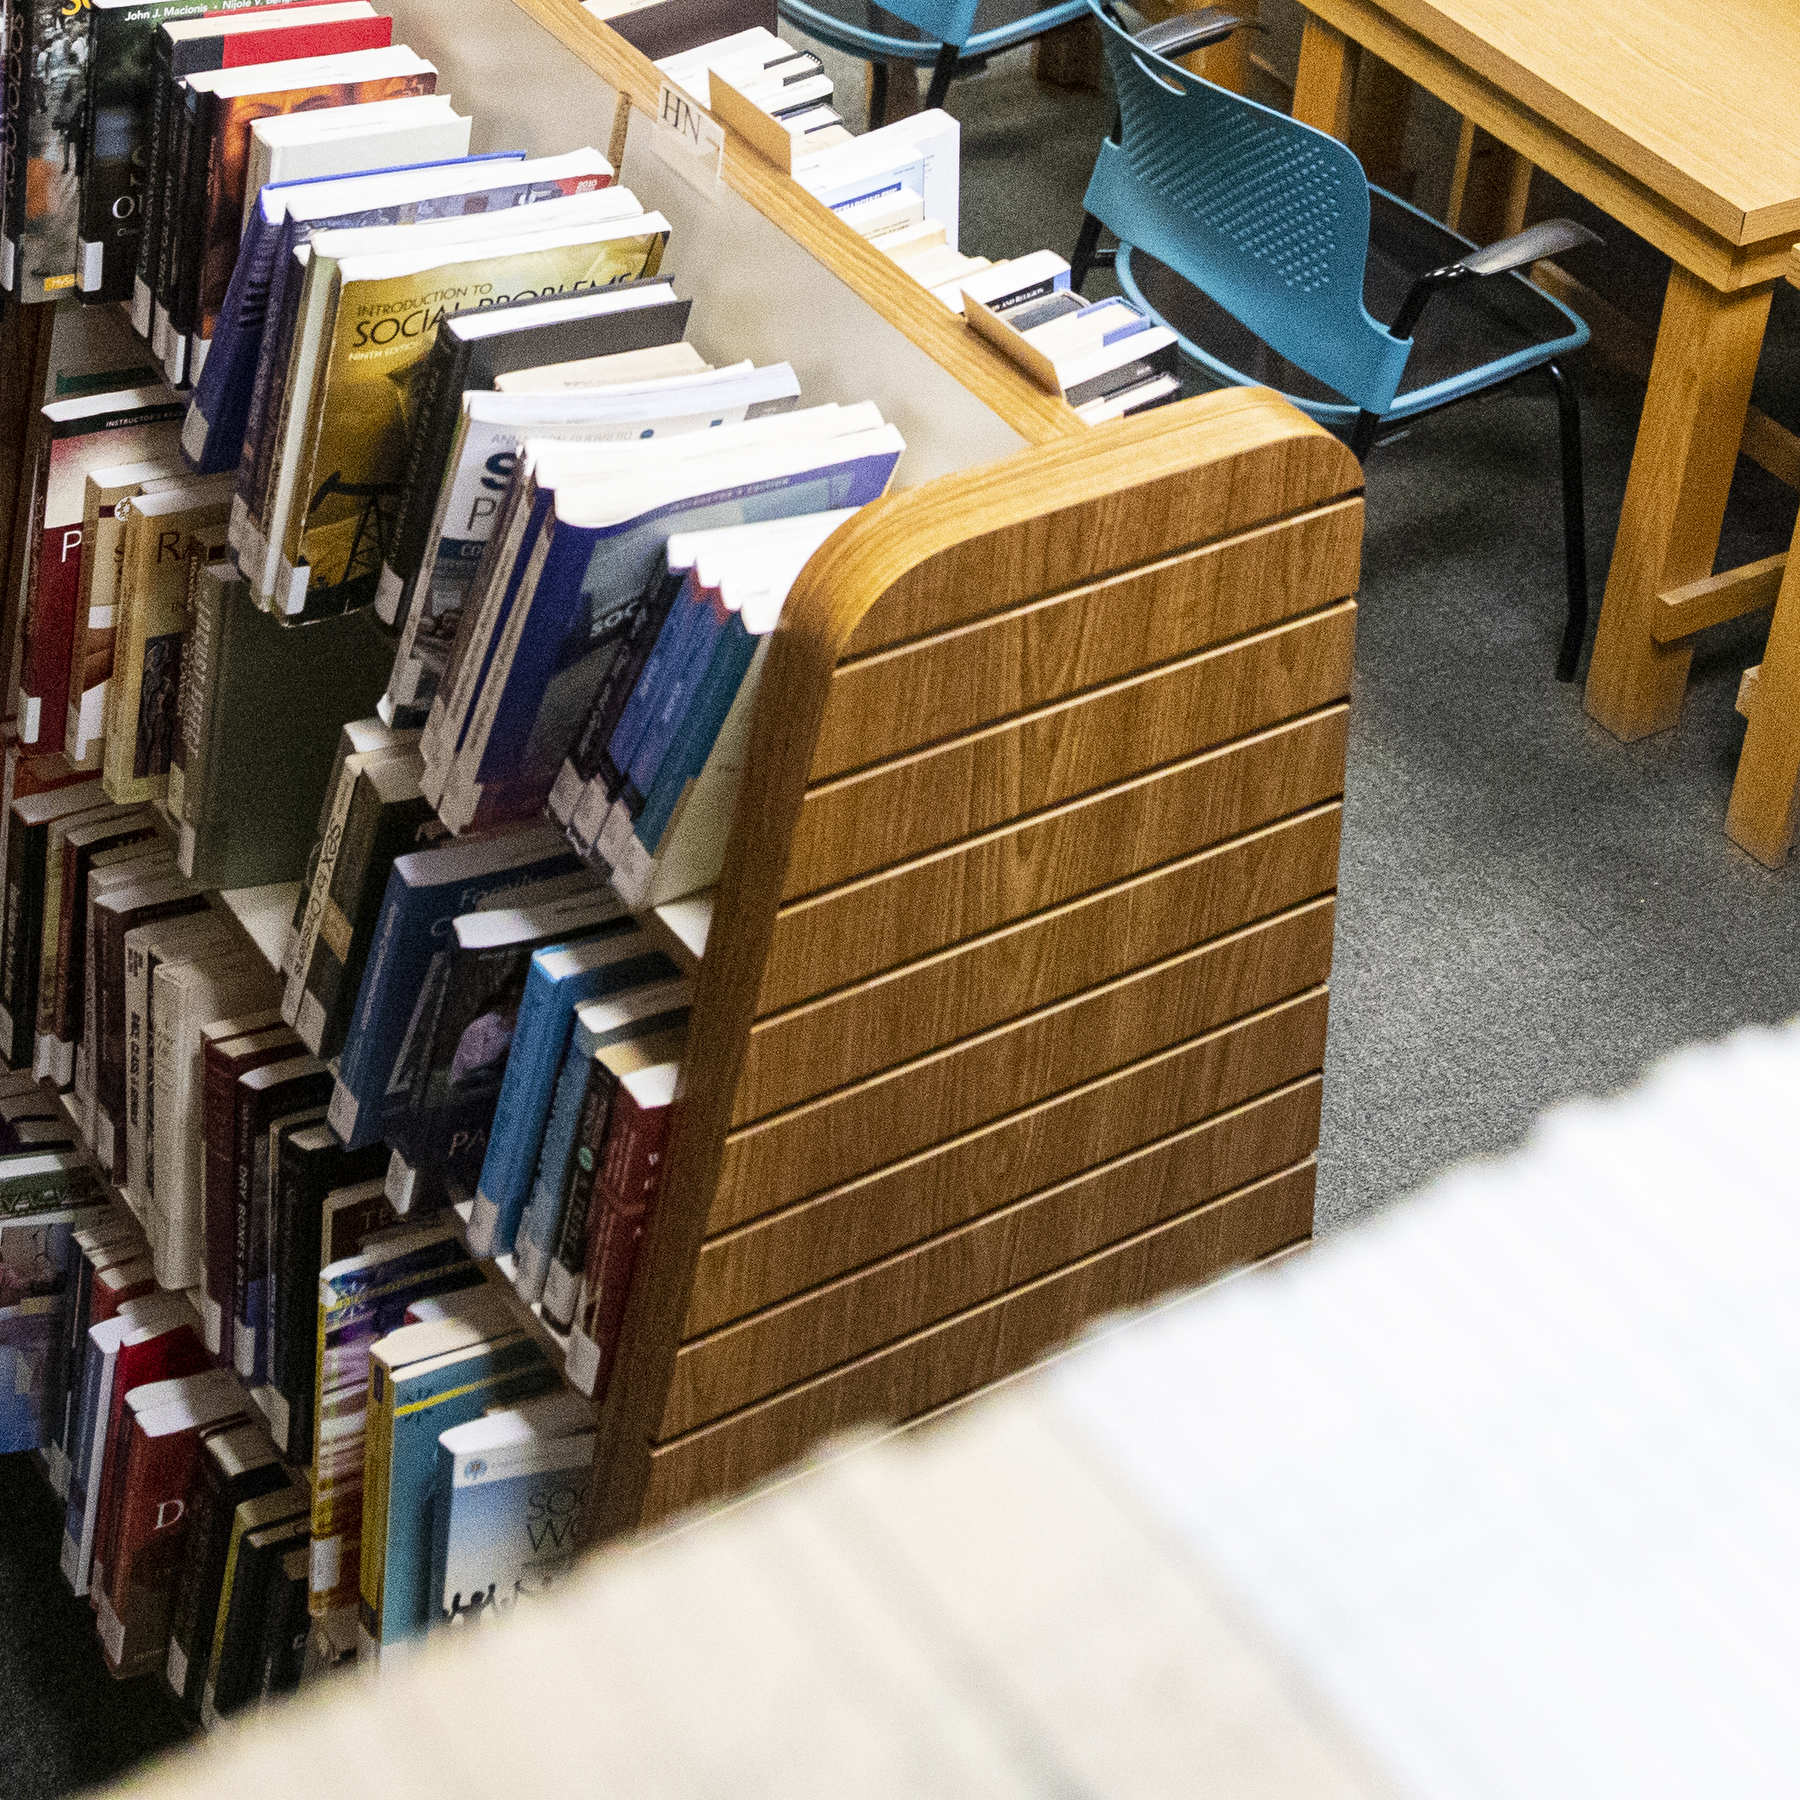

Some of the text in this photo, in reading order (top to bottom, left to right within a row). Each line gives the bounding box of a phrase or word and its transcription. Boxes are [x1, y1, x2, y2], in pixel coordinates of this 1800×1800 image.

[125, 8, 149, 21] John
[152, 5, 162, 18] J.
[163, 3, 208, 17] Macionis
[2, 11, 24, 198] SOCIOLOGY
[662, 88, 702, 145] HN
[356, 283, 493, 319] INTRODUCTION TO
[349, 350, 382, 363] NINTH
[237, 1164, 248, 1199] DRY
[236, 1203, 246, 1261] BONES
